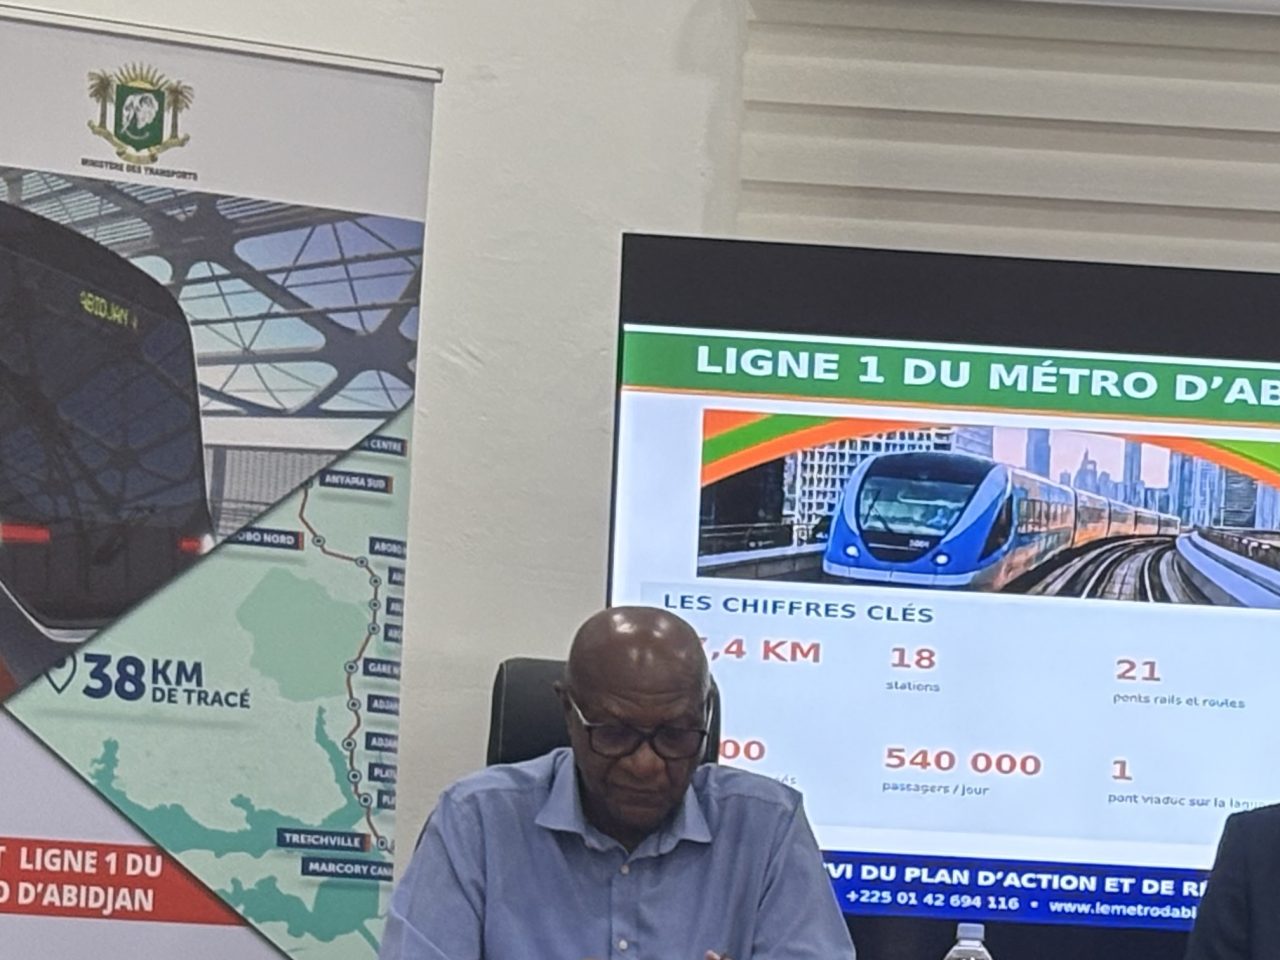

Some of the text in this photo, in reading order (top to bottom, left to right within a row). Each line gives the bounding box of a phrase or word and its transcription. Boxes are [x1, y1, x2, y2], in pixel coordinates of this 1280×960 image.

[697, 345, 840, 381] LIGNE
[859, 356, 885, 383] 1
[903, 357, 971, 388] DU
[988, 360, 1158, 400] MÉTRO
[263, 533, 295, 545] NORD
[664, 594, 934, 623] LES CHIFFRES CLÉS
[762, 639, 821, 663] KM
[890, 647, 936, 670] 18
[82, 653, 203, 701] 38 KM
[1116, 658, 1161, 682] 21
[886, 680, 941, 692] stations
[152, 687, 251, 709] DE TRACÉ
[1113, 693, 1246, 709] ponts rails et routes
[884, 747, 1042, 776] 540 000
[1112, 760, 1133, 781] 1
[882, 780, 951, 795] passagers
[961, 783, 991, 797] jour
[1108, 794, 1138, 805] pont
[1141, 795, 1186, 806] viaduc
[1189, 798, 1211, 807] sur
[1213, 797, 1226, 808] la
[284, 833, 361, 847] TREICHVILLE
[20, 847, 98, 874] LIGNE
[105, 852, 117, 875] 1
[126, 853, 162, 877] DU
[309, 861, 394, 876] MARCORY CAN
[861, 865, 896, 881] DU
[904, 867, 969, 885] PLAN
[977, 870, 1097, 892] D’ACTION
[1104, 877, 1136, 893] ET
[1141, 879, 1175, 895] DE
[18, 881, 154, 916] D’ABIDJAN
[846, 890, 1197, 919] +225 01 42 694 116 www.lemetrodabi
